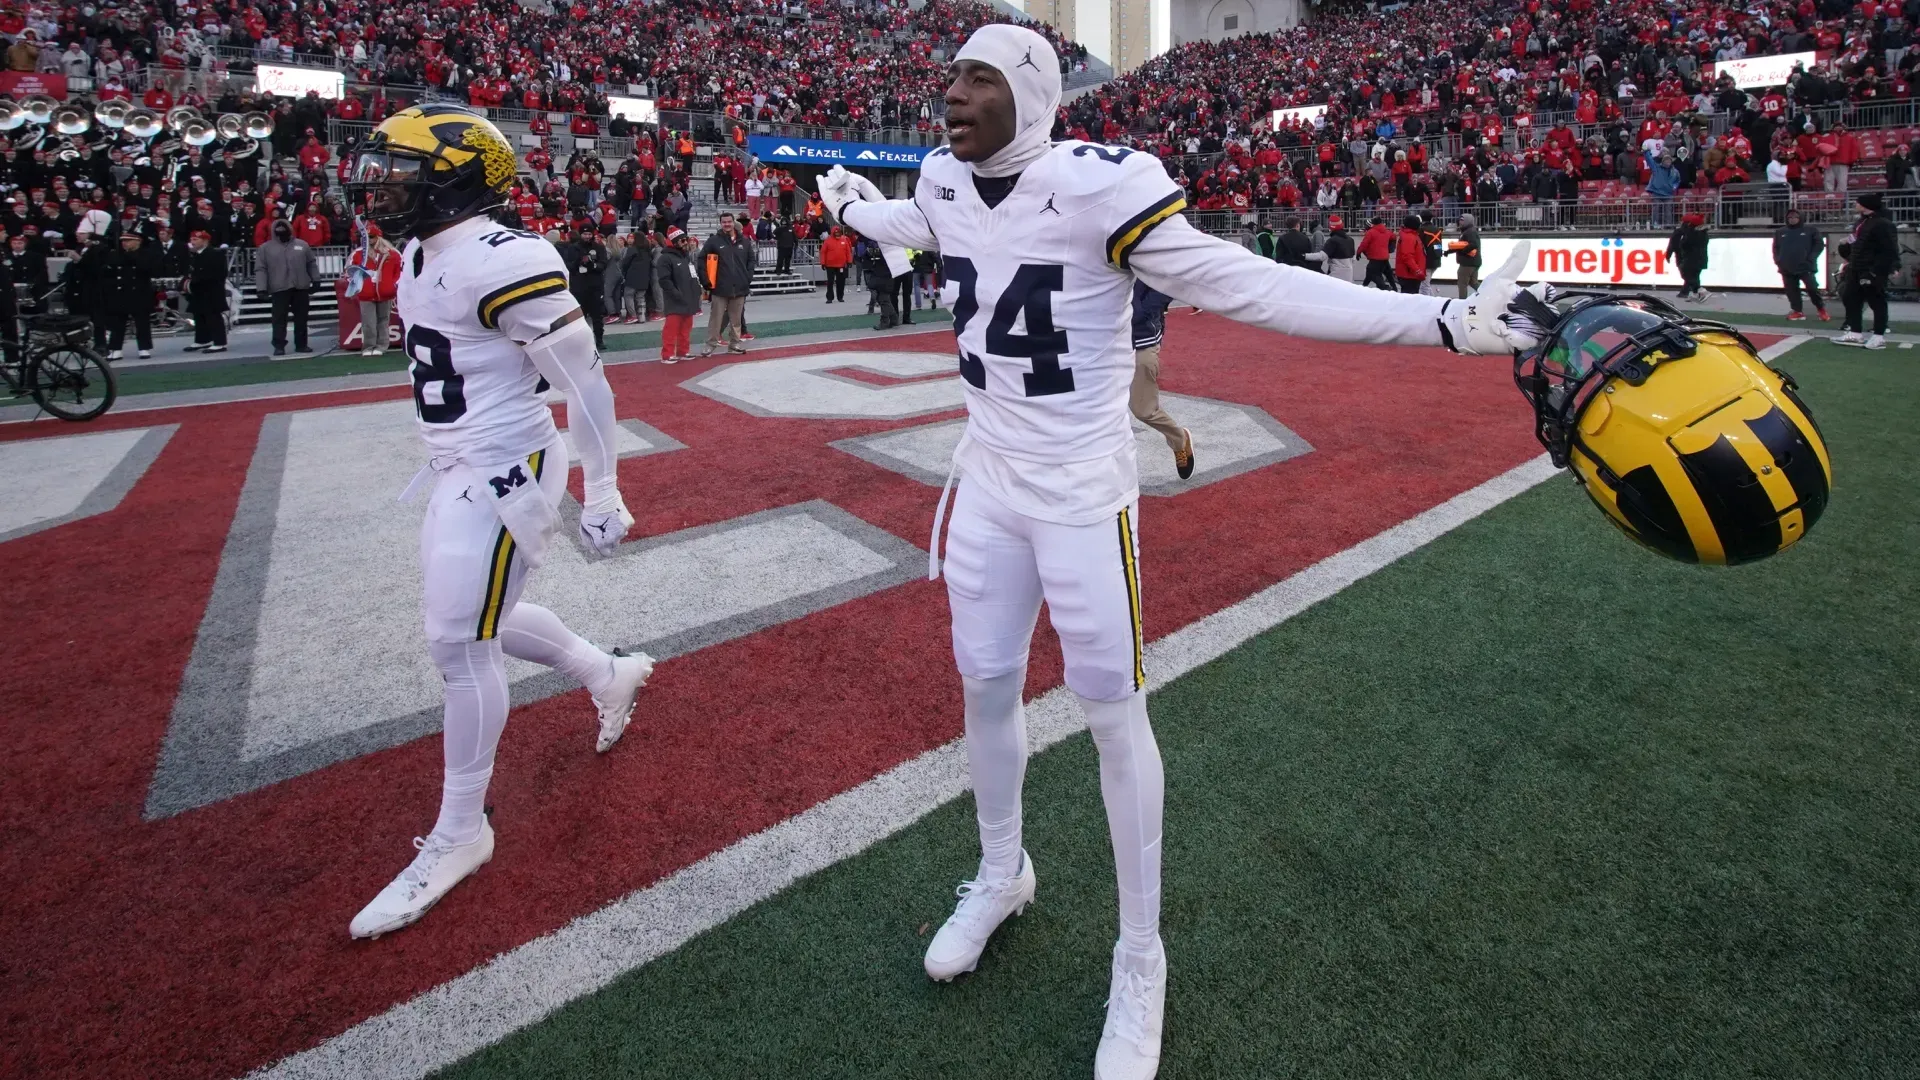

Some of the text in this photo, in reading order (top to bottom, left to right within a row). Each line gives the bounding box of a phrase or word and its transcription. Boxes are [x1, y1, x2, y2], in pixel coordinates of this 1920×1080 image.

[1763, 99, 1780, 112] 10
[799, 147, 846, 159] FEAZEL
[879, 151, 921, 163] FEAZEL
[1537, 237, 1668, 283] meijer
[940, 254, 1076, 398] 24
[406, 323, 468, 424] 8
[488, 464, 528, 499] M
